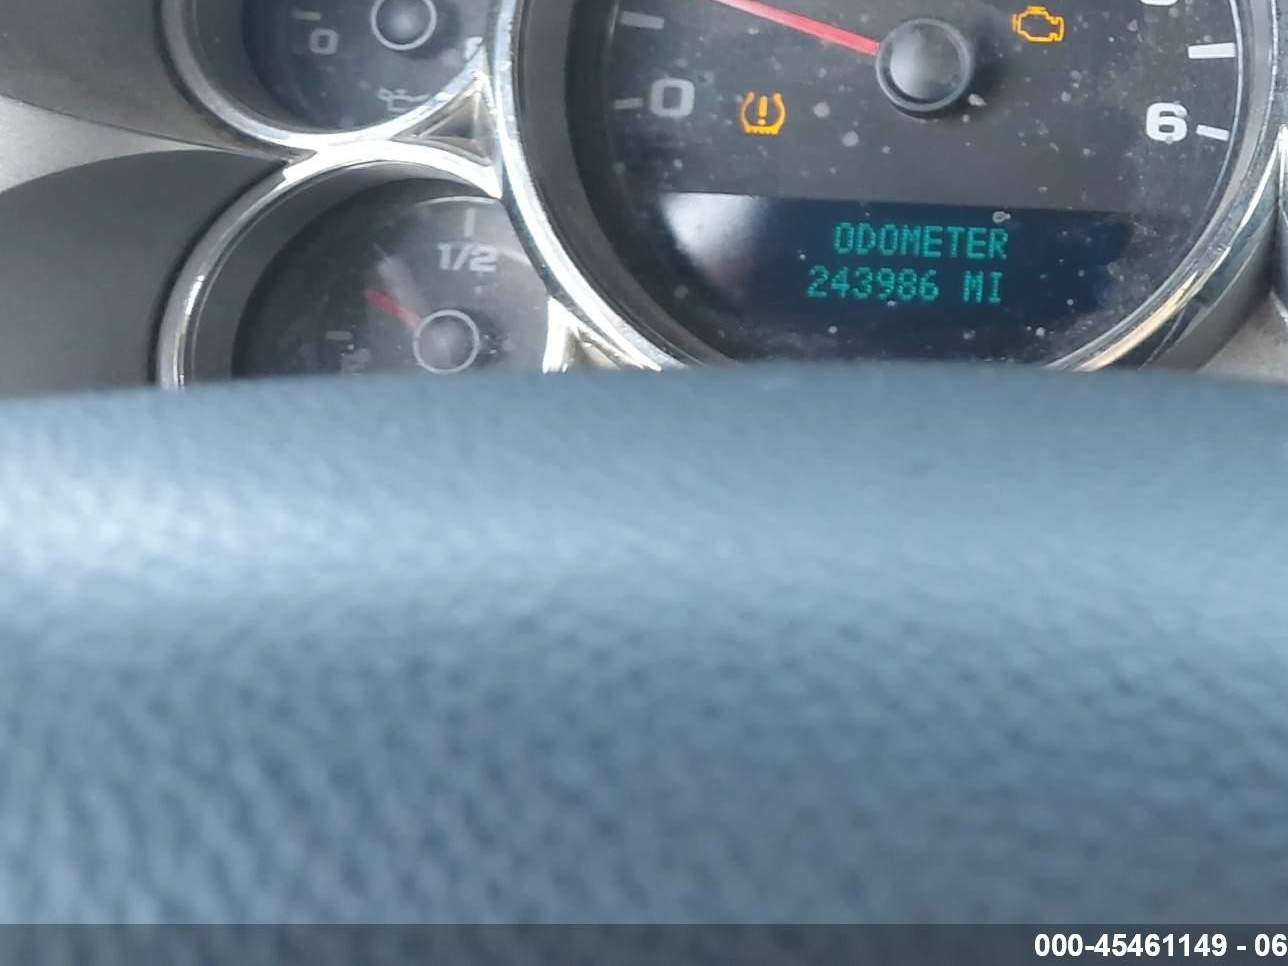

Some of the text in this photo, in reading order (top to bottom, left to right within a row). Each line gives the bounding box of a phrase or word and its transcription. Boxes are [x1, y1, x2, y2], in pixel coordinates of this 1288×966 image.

[650, 76, 695, 118] 0
[1145, 101, 1188, 143] 6
[435, 241, 498, 274] 1/2
[832, 221, 1009, 260] ODOMETER
[806, 265, 1005, 304] 243986 MI
